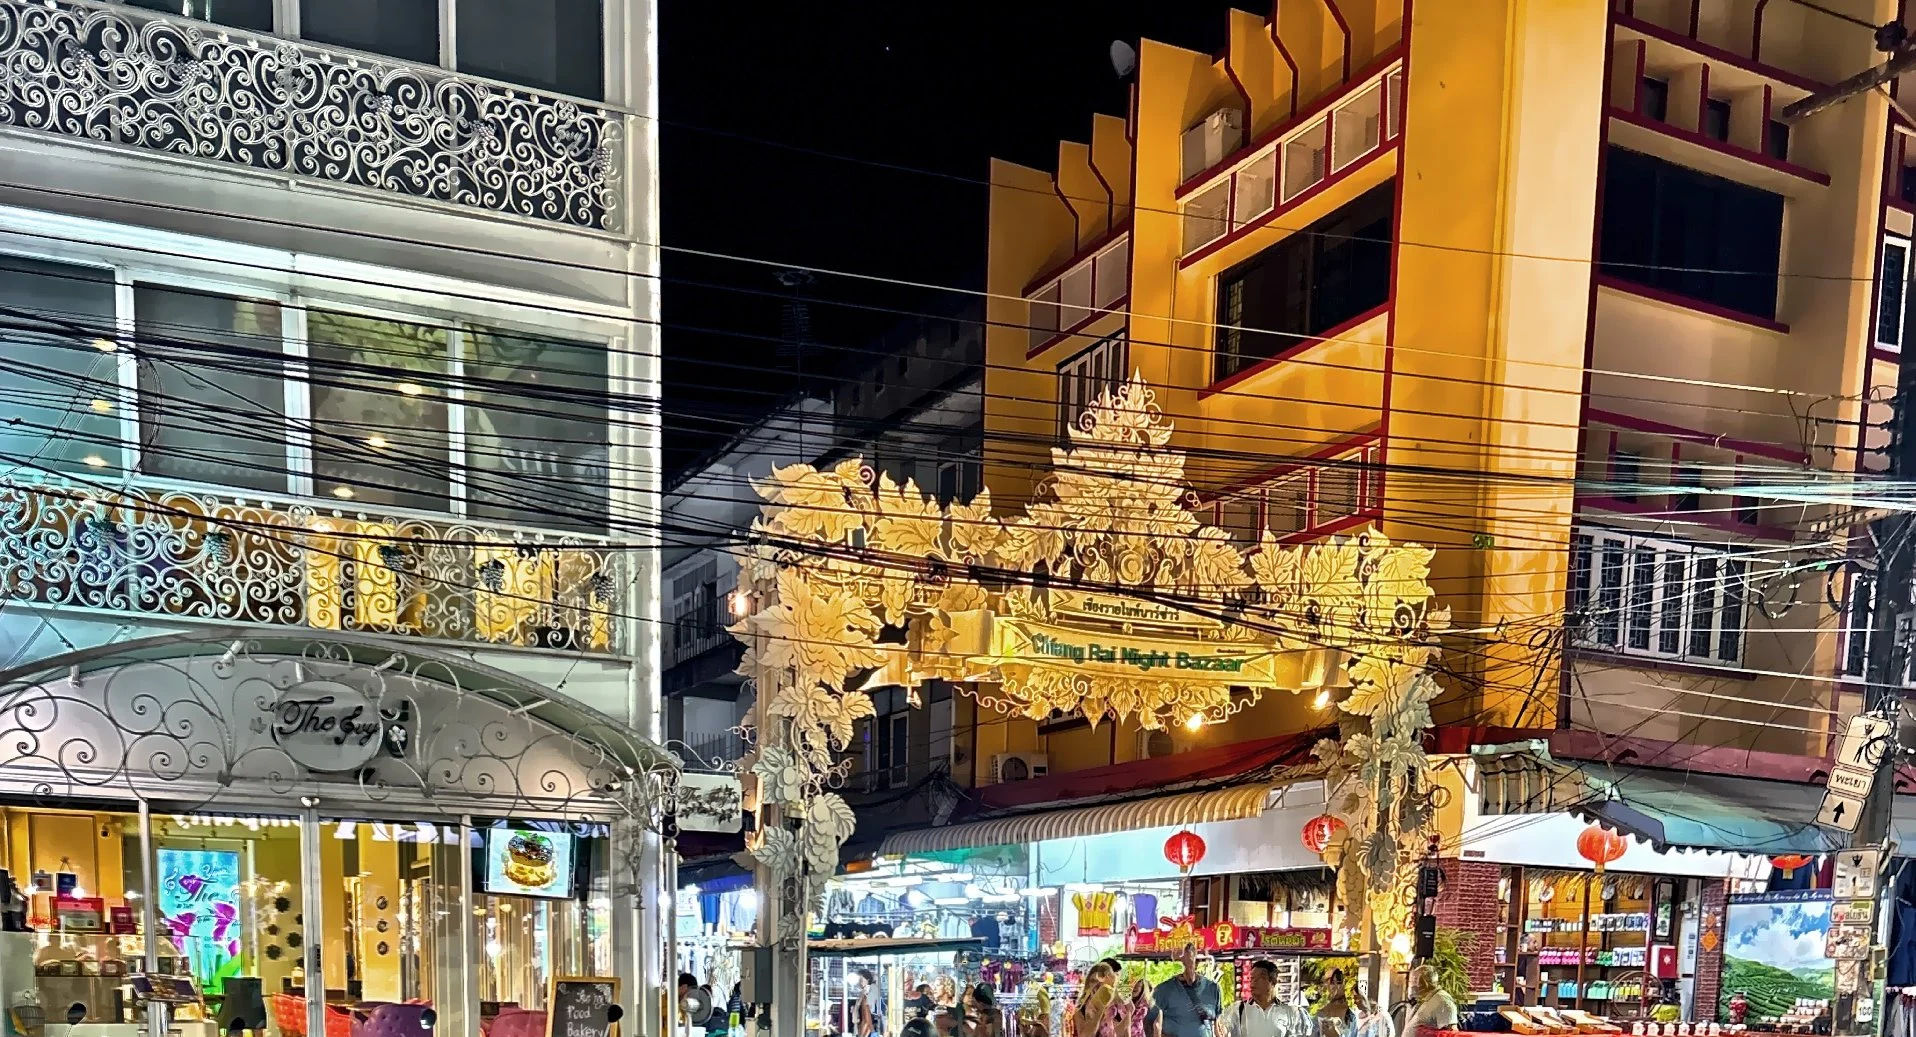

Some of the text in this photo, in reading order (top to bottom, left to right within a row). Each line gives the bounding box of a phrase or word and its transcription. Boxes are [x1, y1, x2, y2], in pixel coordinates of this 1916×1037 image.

[1031, 632, 1246, 672] Chiang Rai Night Bazaar
[278, 696, 335, 734] The
[1835, 774, 1867, 790] พะเยา
[566, 1005, 592, 1020] Food
